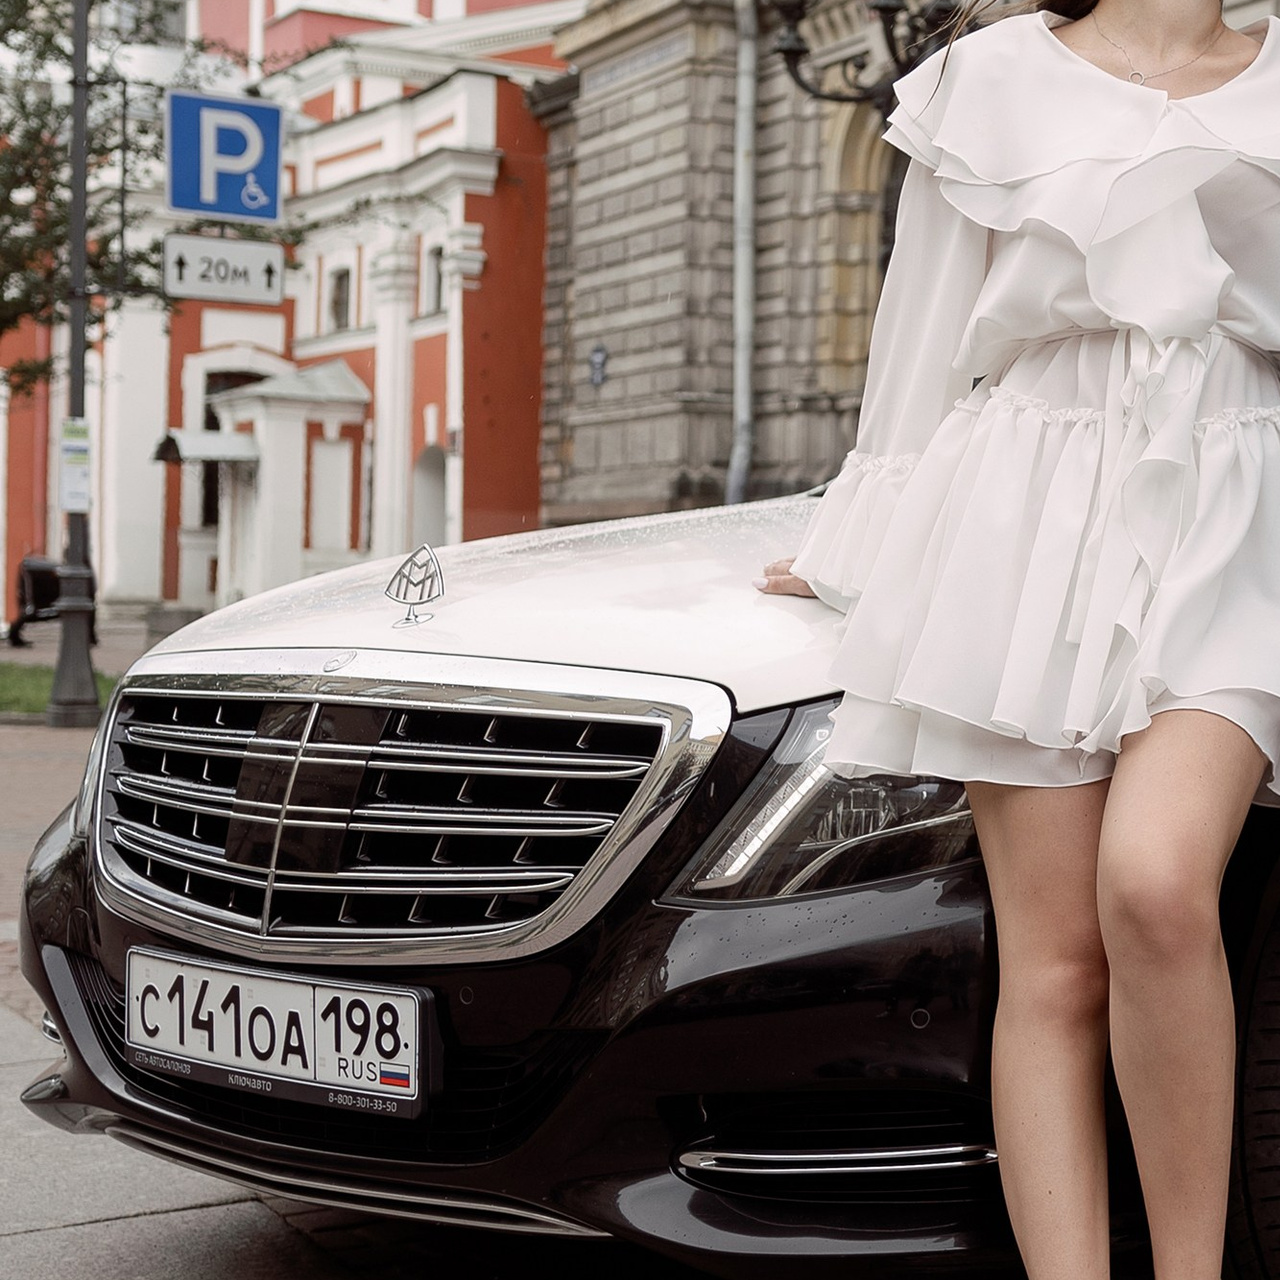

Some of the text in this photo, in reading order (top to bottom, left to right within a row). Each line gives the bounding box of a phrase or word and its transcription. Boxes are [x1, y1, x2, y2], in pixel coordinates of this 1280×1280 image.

[200, 106, 264, 205] P
[320, 995, 401, 1060] 198
[135, 1051, 191, 1075] СЕТЬ АВТОСАЛОНОВ
[338, 1057, 377, 1082] RUS
[328, 1092, 397, 1113] 8-800-301-33-50
